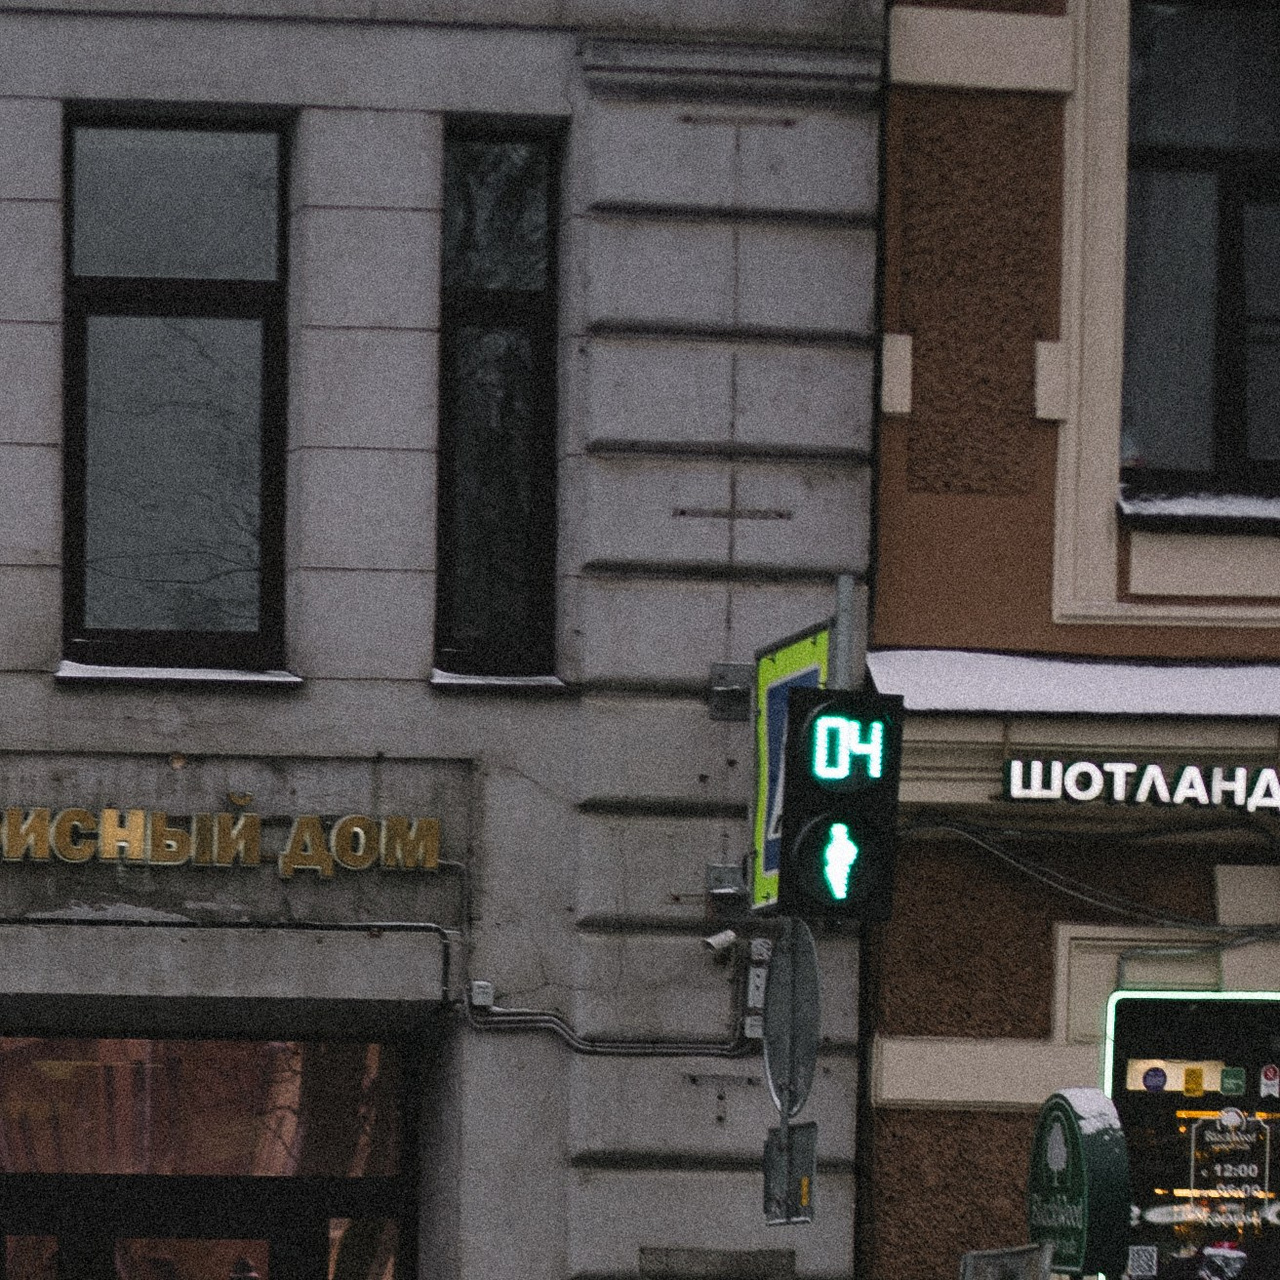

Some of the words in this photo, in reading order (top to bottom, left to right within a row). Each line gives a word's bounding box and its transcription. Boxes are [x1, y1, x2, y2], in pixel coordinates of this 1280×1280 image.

[814, 715, 884, 779] 04
[1010, 760, 1280, 813] ШОТЛАНД
[278, 812, 441, 878] ДОМ
[1214, 1163, 1259, 1178] 12:00
